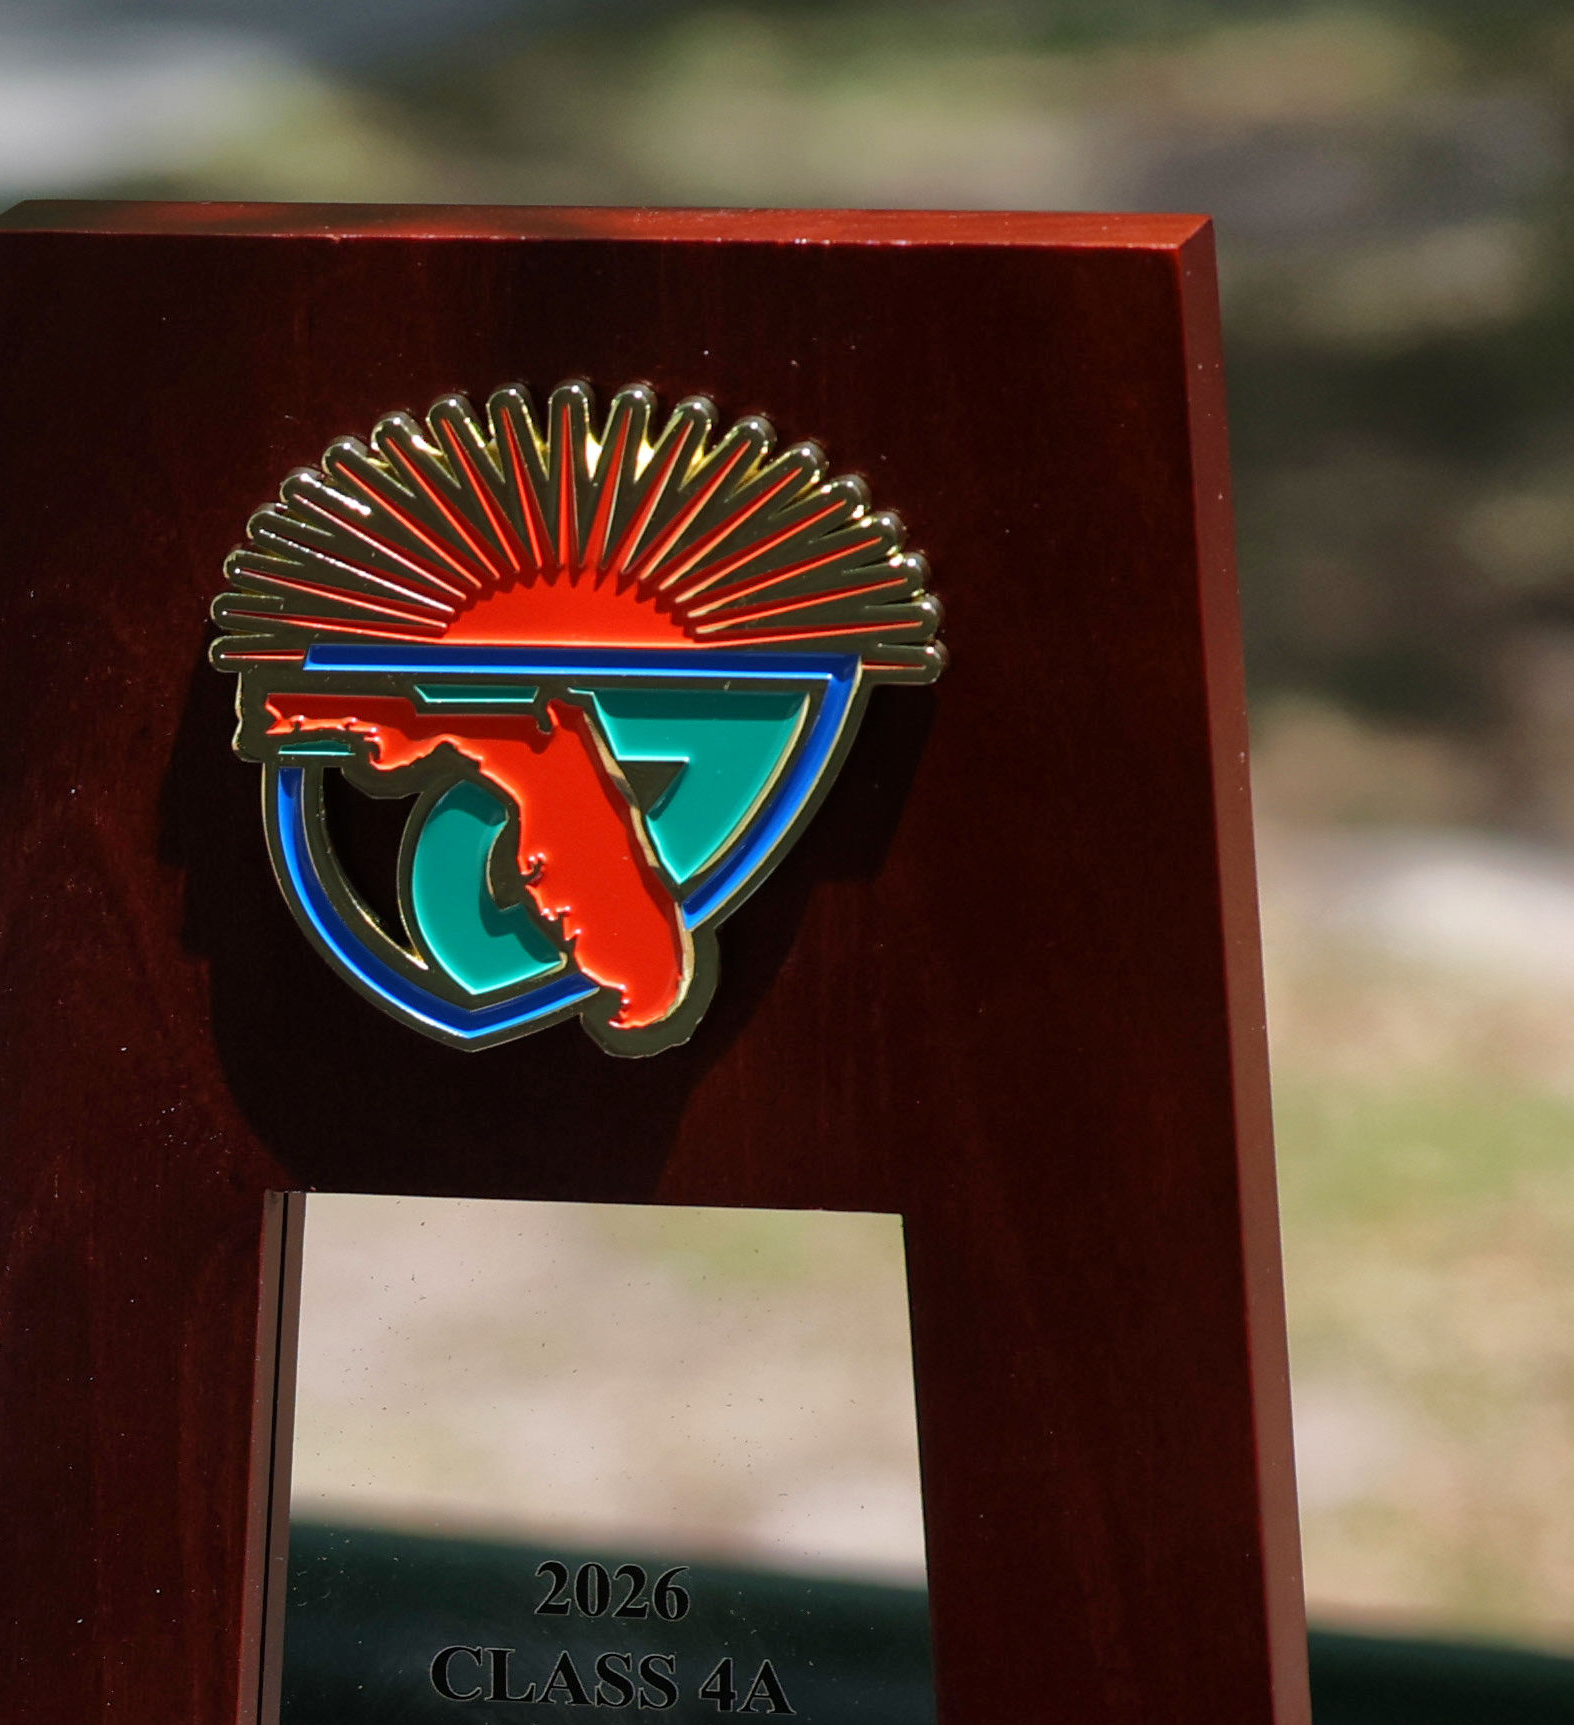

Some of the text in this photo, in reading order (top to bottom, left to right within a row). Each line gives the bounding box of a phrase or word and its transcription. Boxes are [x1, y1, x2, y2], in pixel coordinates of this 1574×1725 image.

[535, 1561, 689, 1621] 2026
[430, 1646, 796, 1714] CLASS 4A
